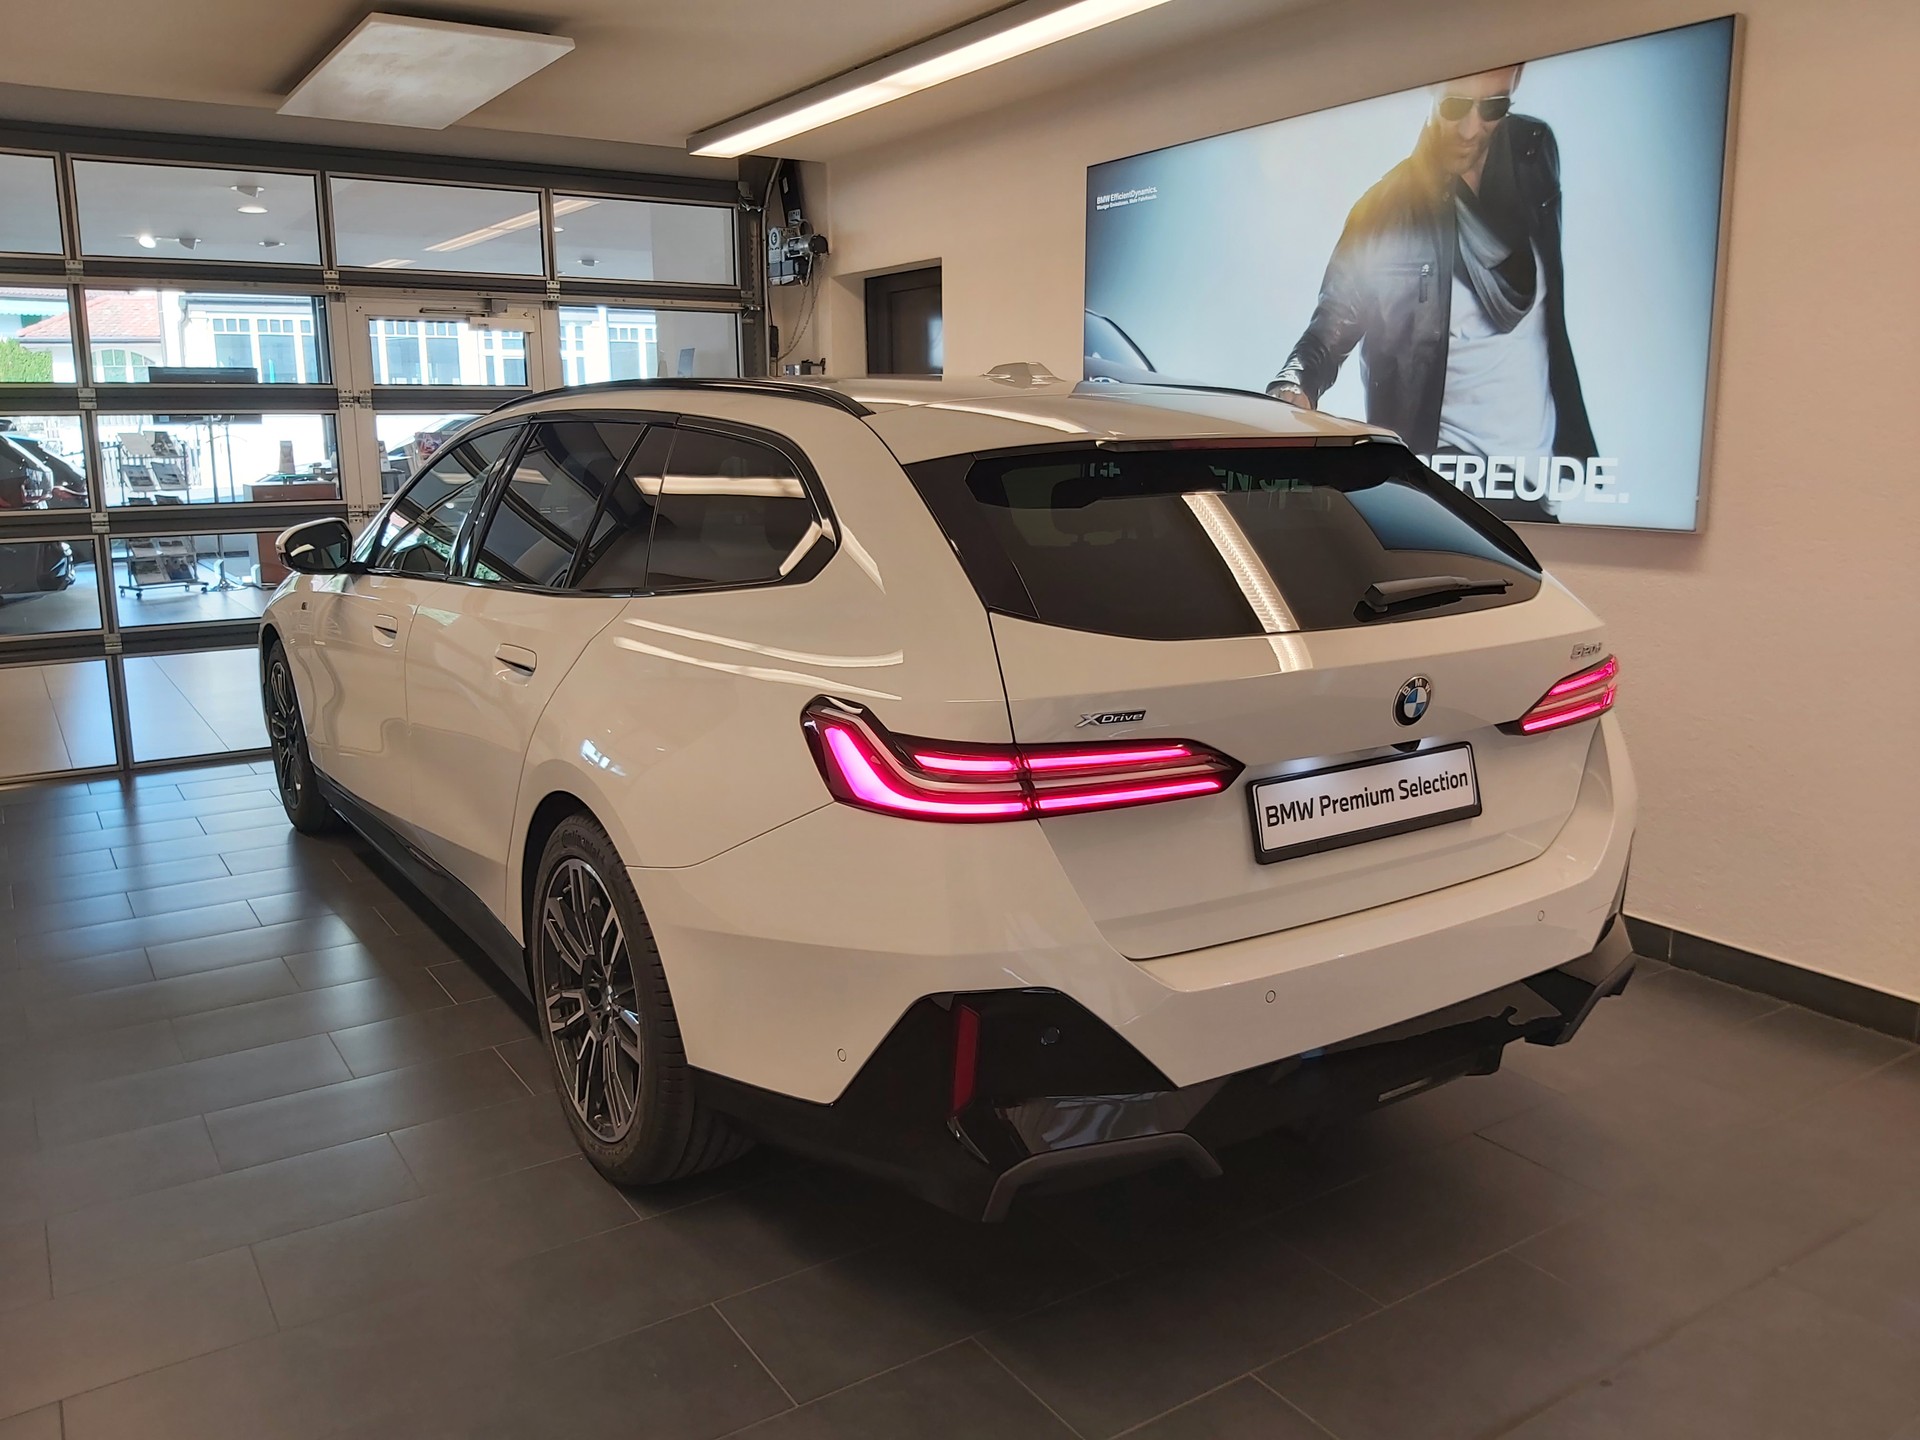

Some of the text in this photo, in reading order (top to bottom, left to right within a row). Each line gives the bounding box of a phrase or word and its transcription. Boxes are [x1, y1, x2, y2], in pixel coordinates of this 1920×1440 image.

[1415, 454, 1630, 504] FREUDE.
[1402, 678, 1431, 696] BMW
[1265, 771, 1469, 828] BMW Premium Selection
